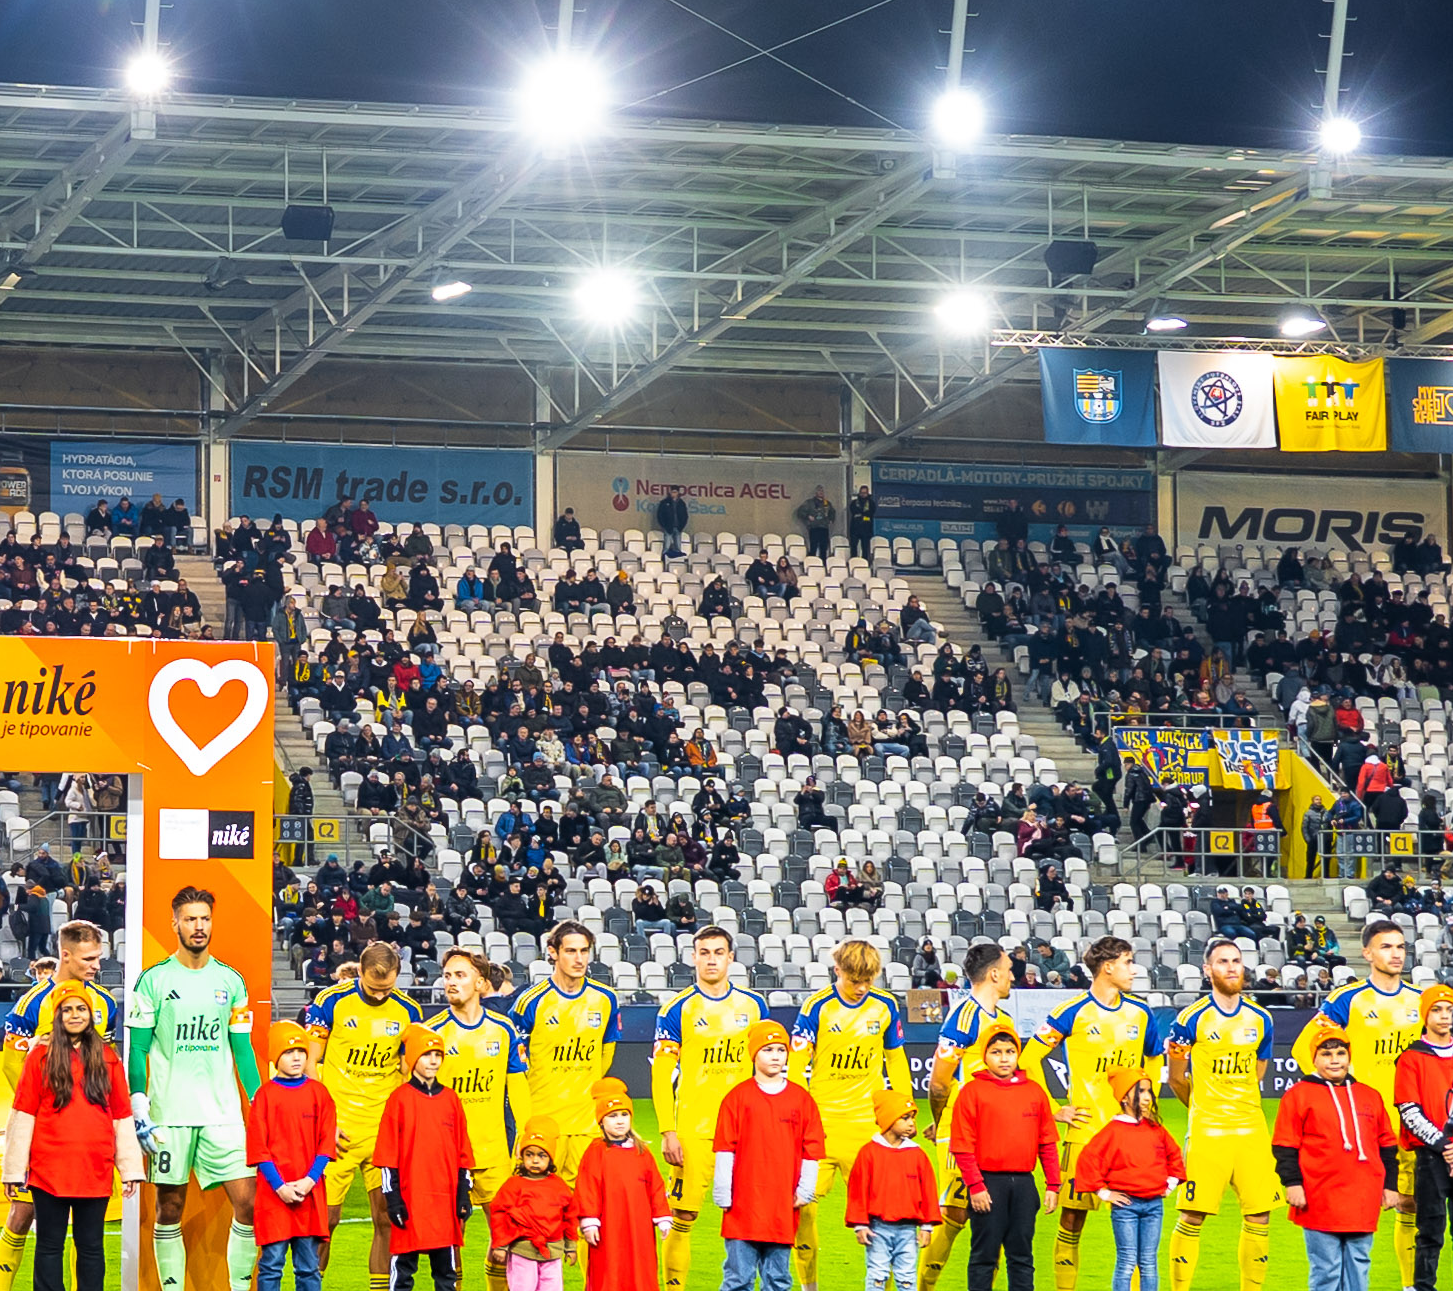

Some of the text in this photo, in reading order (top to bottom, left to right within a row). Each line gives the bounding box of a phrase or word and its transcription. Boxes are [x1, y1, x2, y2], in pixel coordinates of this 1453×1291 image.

[1305, 411, 1329, 421] FAIR
[62, 453, 137, 468] HYDRATÁCIA,
[1, 481, 27, 489] OWER
[62, 467, 154, 482] KTORÁ POSUNIE
[243, 464, 523, 506] RSM trade s.r.o.
[1088, 475, 1145, 489] SPOJKY
[62, 483, 133, 497] TVOJ VÝKON
[739, 483, 792, 500] AGEL
[1197, 506, 1425, 553] MORIS
[2, 664, 97, 716] niké
[0, 720, 93, 739] je tipovanie
[211, 823, 250, 846] niké
[318, 822, 335, 838] C2
[1214, 835, 1230, 850] C2
[1394, 837, 1409, 851] C1
[176, 1014, 220, 1041] niké
[346, 1043, 393, 1069] niké
[552, 1037, 596, 1063] niké
[703, 1039, 745, 1065] niké
[830, 1046, 872, 1071] niké
[1212, 1050, 1253, 1075] niké
[452, 1067, 494, 1094] niké
